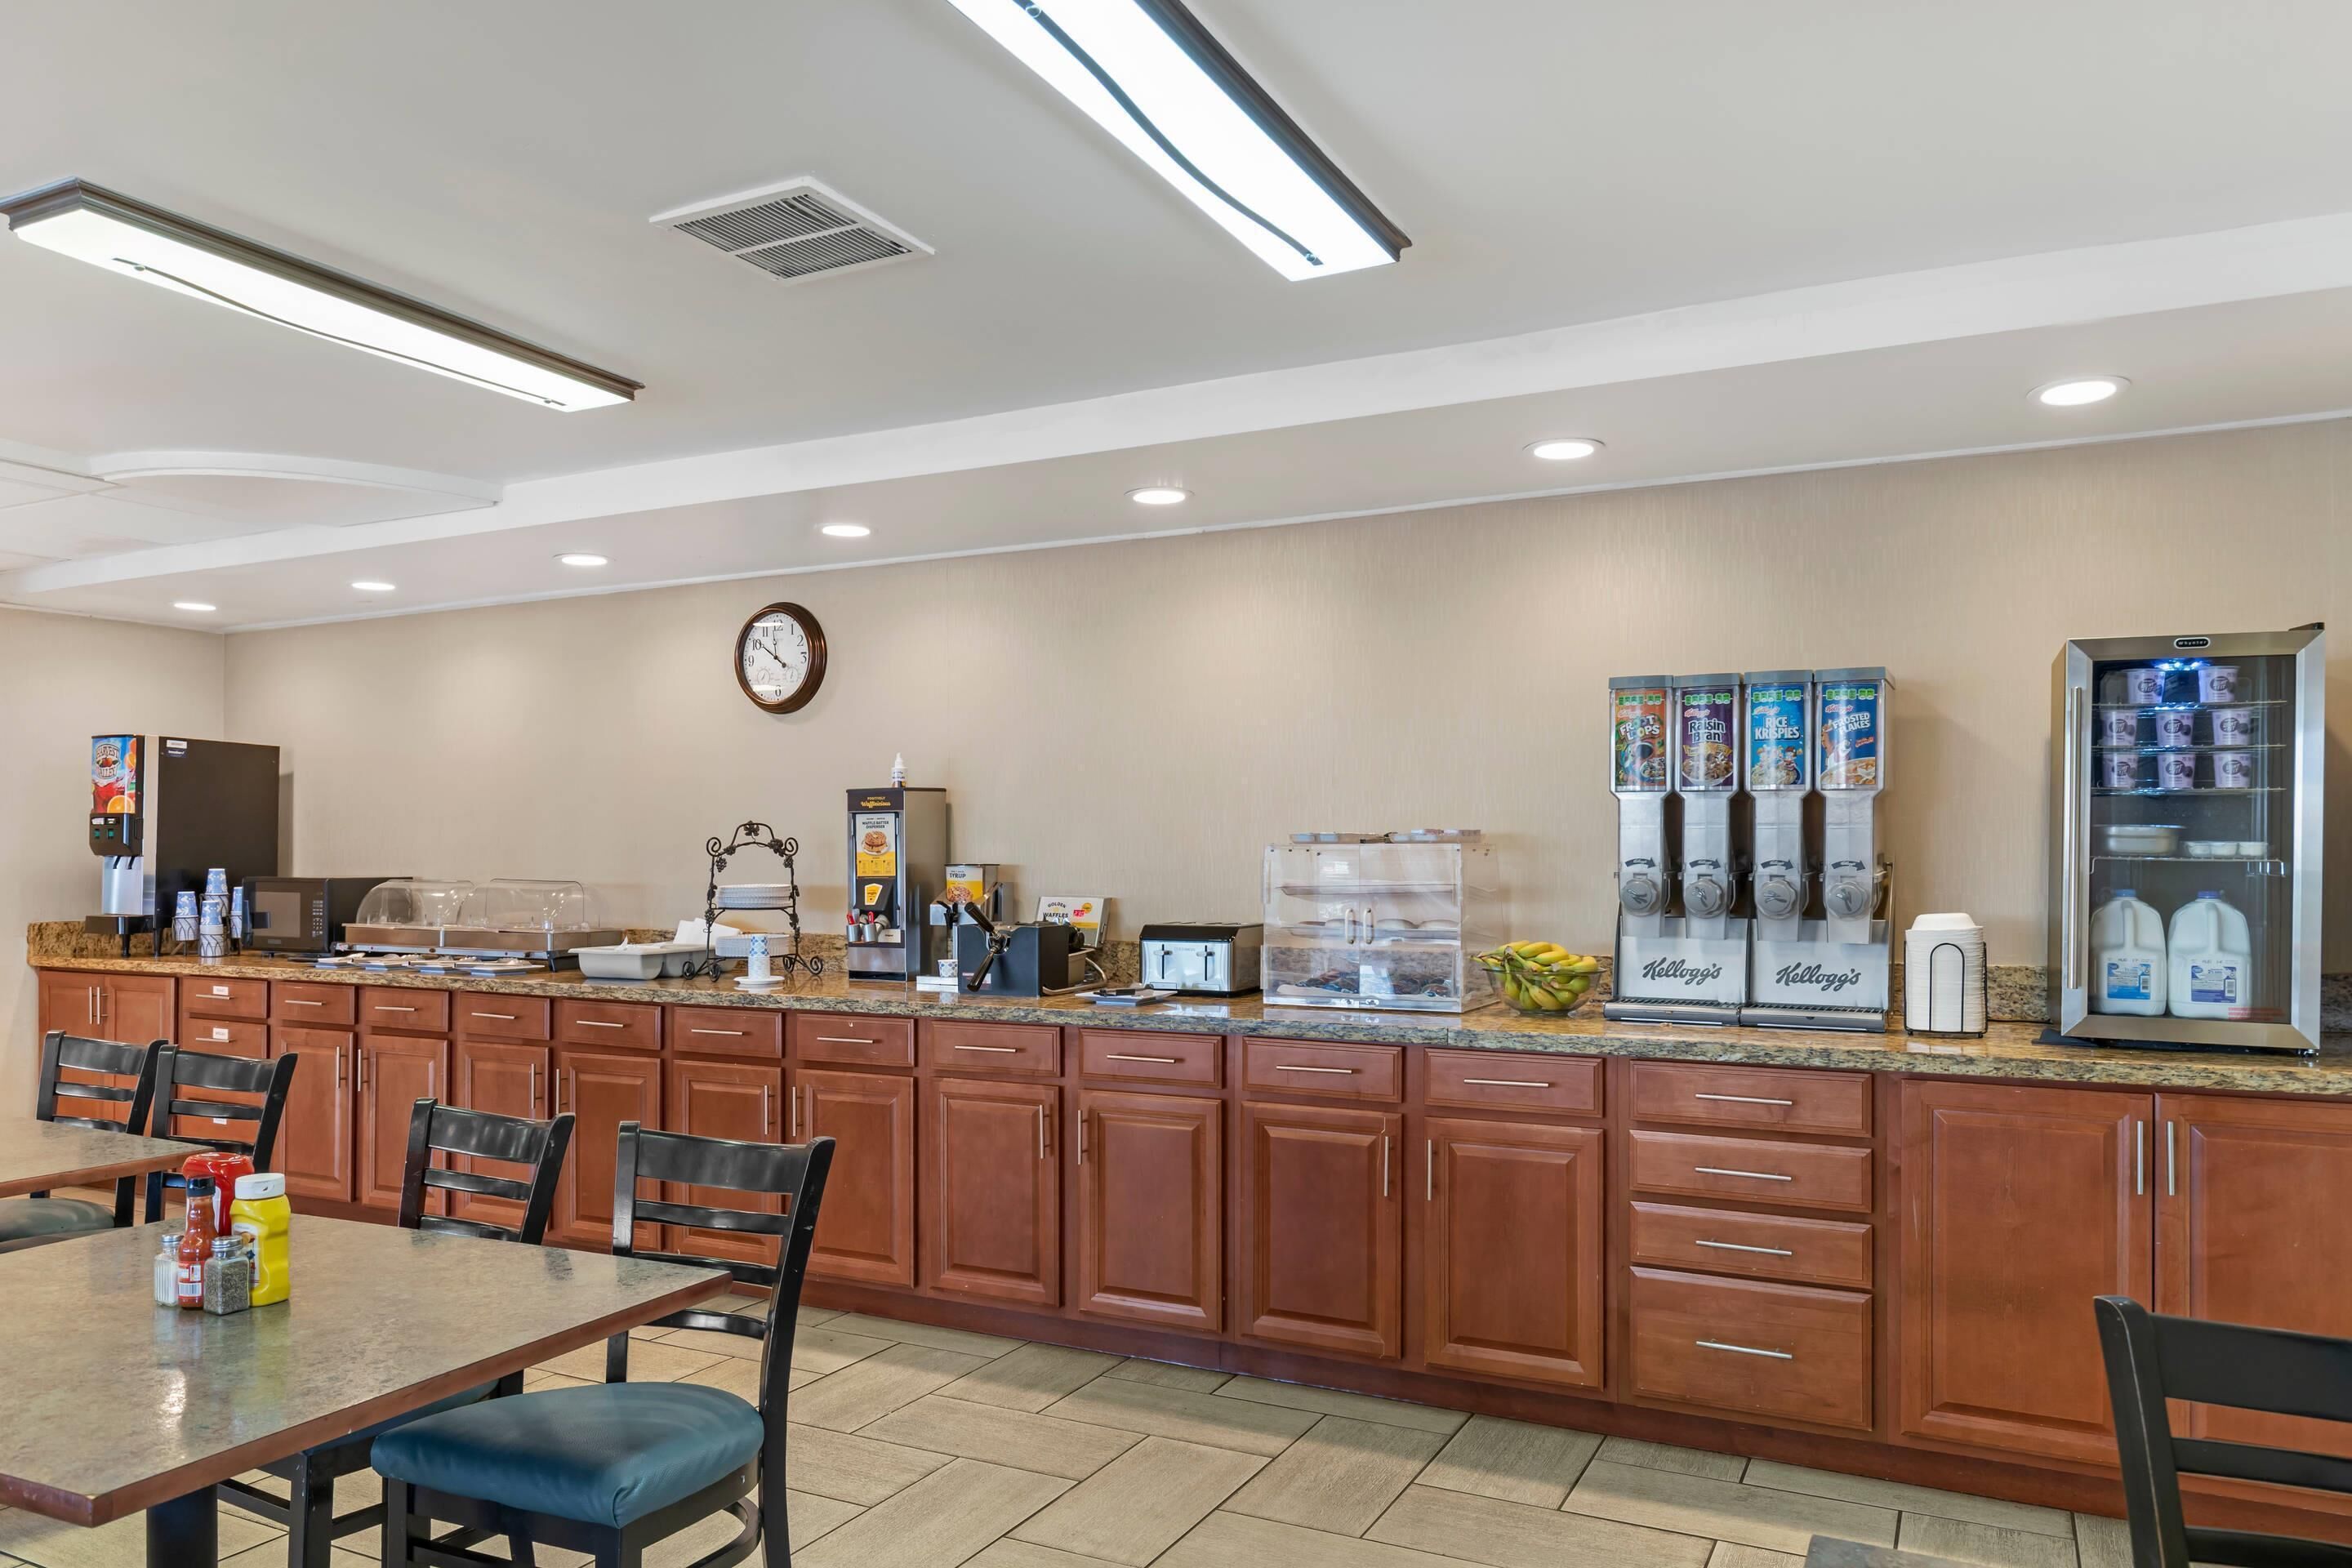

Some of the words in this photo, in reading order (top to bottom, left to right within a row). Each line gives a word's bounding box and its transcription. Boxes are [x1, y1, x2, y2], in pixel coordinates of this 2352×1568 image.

[791, 623, 795, 635] 1
[753, 639, 761, 650] 10
[797, 635, 804, 647] 2
[748, 655, 755, 666] 9
[800, 652, 807, 664] 3
[774, 685, 782, 697] 6
[1689, 718, 1726, 733] Raisin
[1765, 716, 1788, 728] RICE
[1833, 712, 1870, 729] FROSTED
[1755, 726, 1800, 741] KRISPIES
[1642, 957, 1722, 986] Kellogg's
[1775, 962, 1862, 991] Kellogg's
